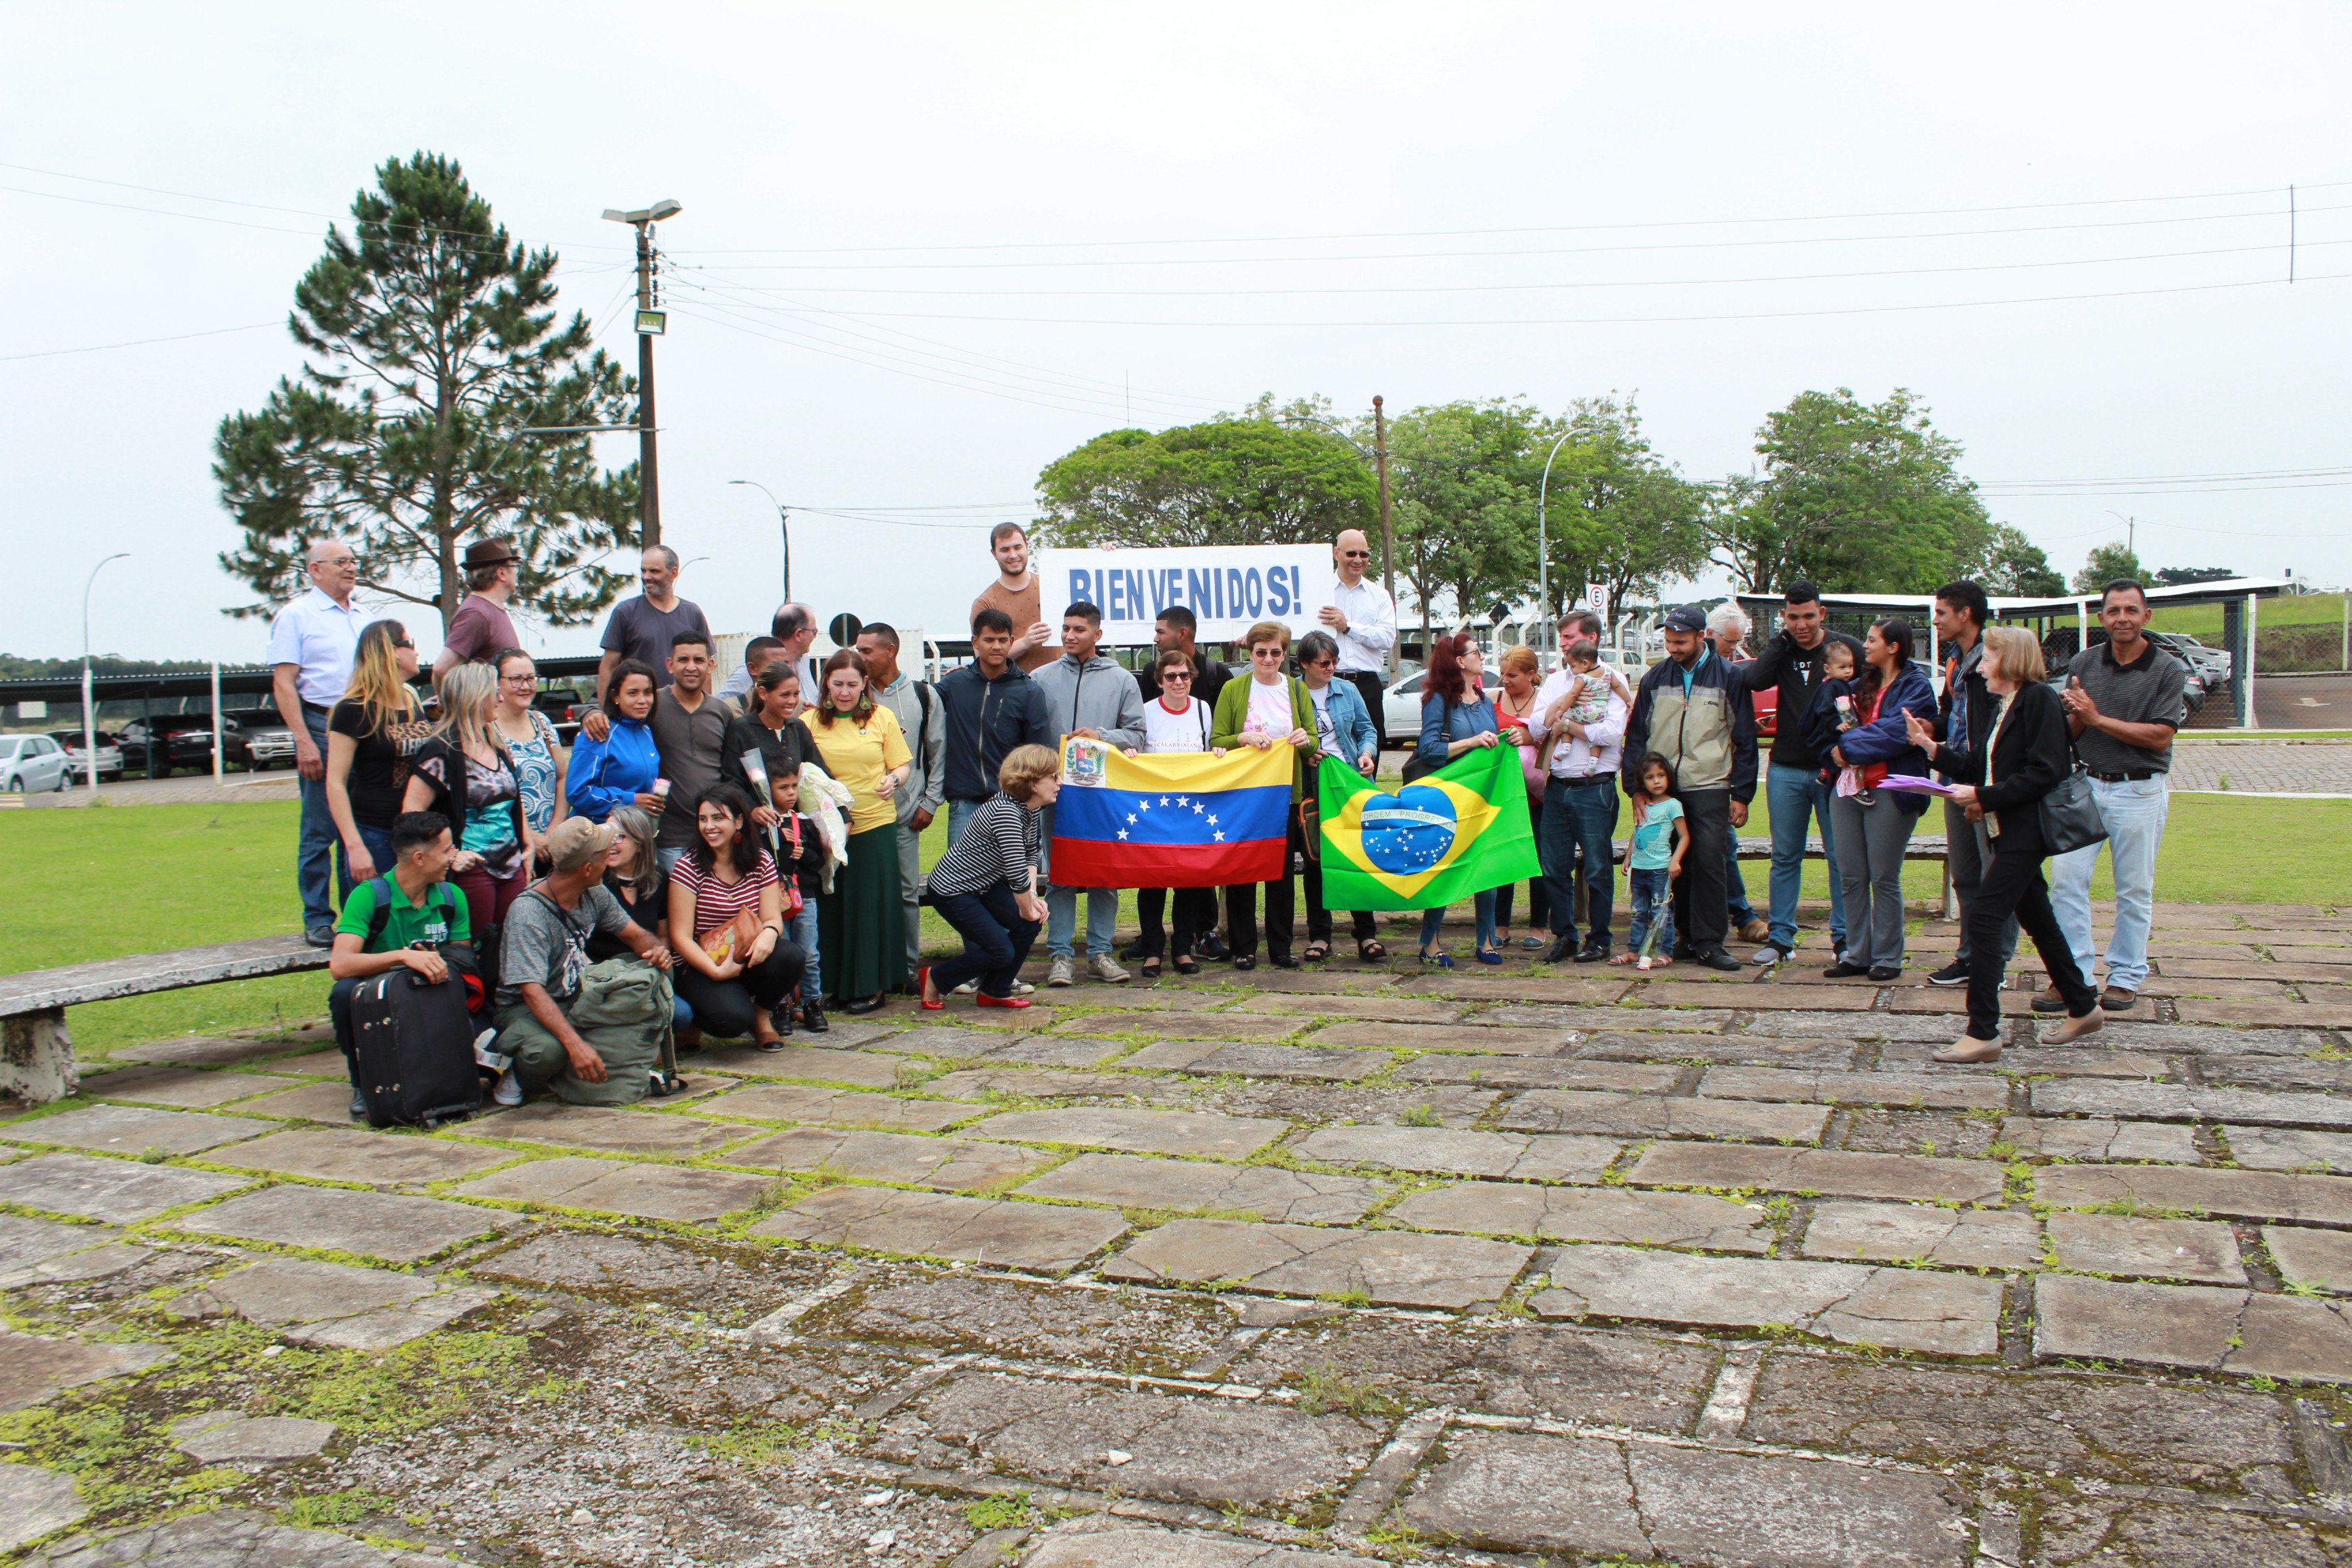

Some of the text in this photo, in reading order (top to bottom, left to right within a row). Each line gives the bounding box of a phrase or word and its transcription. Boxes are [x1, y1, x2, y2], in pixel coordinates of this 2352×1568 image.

[1069, 566, 1302, 620] BIENVENIDOS!
[1595, 591, 1600, 602] E
[1363, 811, 1391, 820] ORDEM
